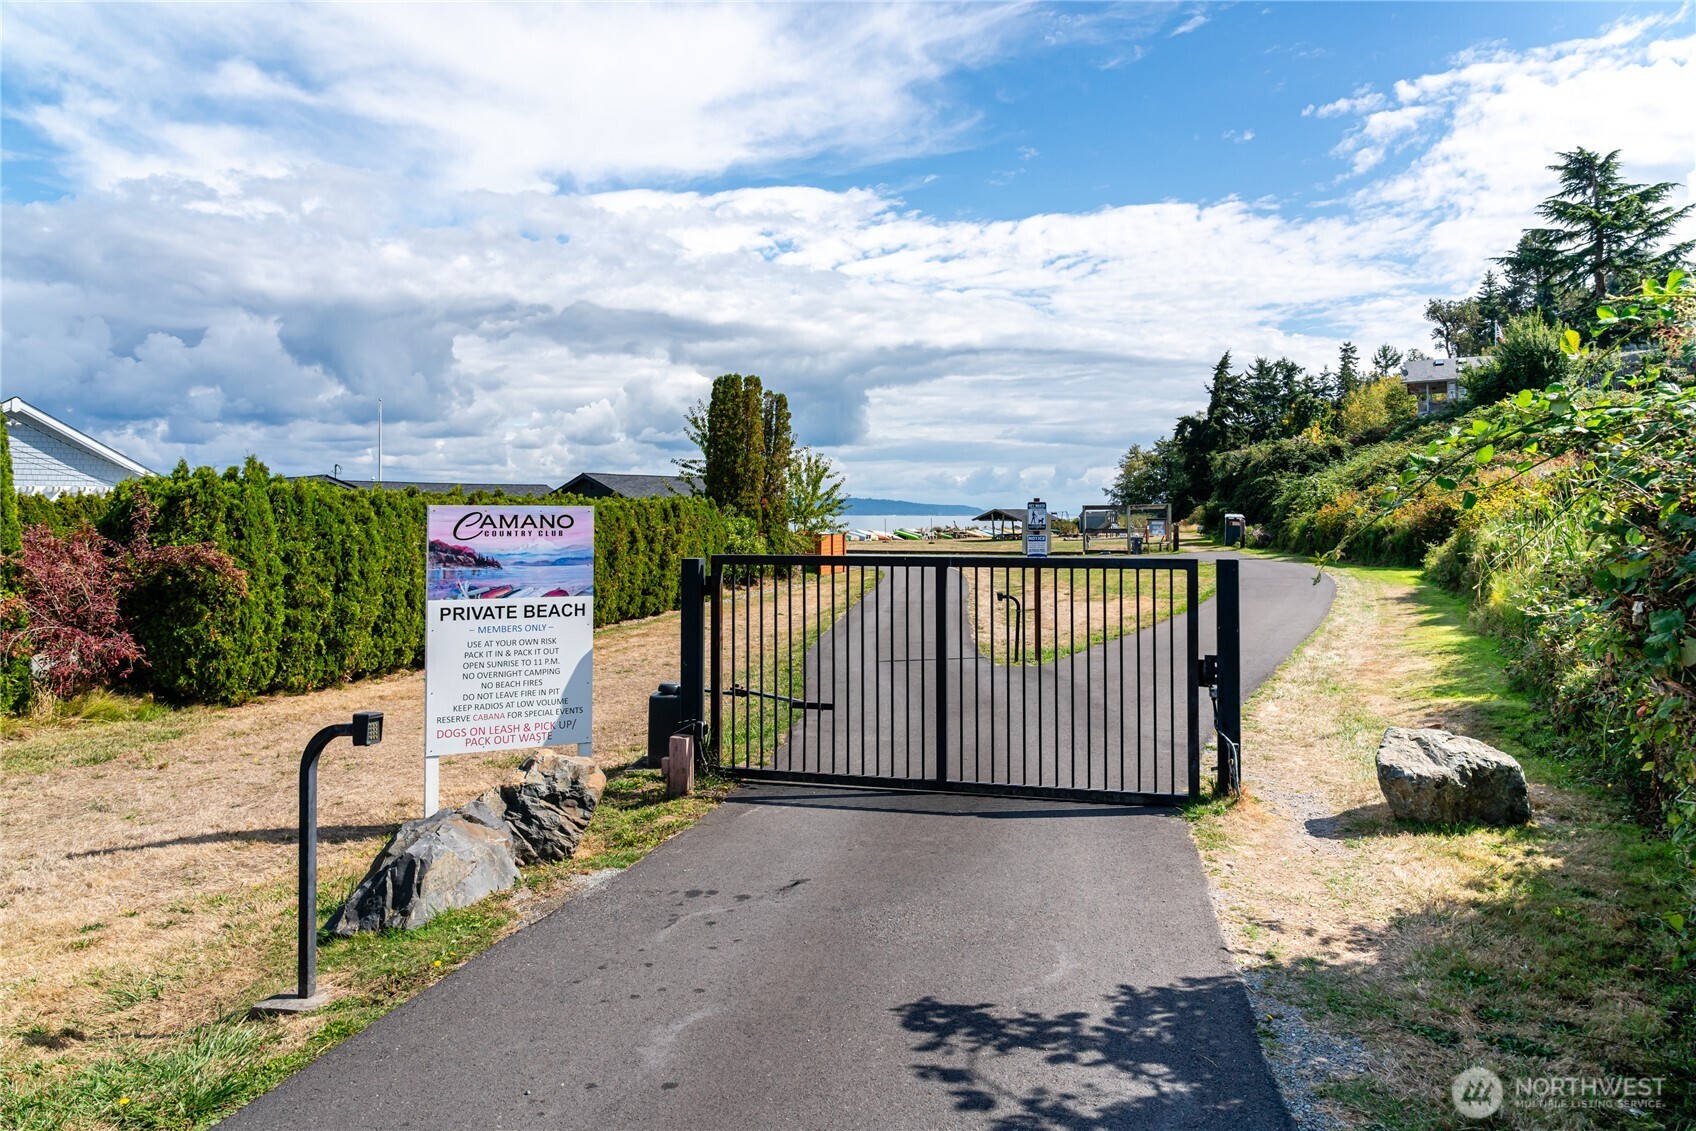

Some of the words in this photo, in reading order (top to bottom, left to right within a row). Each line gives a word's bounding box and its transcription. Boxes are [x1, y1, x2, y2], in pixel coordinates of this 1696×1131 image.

[453, 512, 574, 540] CAMANO
[440, 606, 517, 621] PRIVATE
[524, 603, 585, 618] BEACH
[478, 625, 522, 633] MEMBERS
[487, 660, 519, 668] SUNRISE
[477, 670, 522, 679] OVERNIGHT
[536, 698, 568, 706] VOLUME
[437, 715, 470, 723] RESERVE
[473, 713, 505, 721] CABANA
[525, 709, 553, 717] SPECIAL
[556, 707, 583, 715] EVENTS
[437, 728, 466, 739] DOGS
[470, 727, 485, 736] ON
[489, 724, 520, 734] LEASH
[524, 723, 530, 732] &
[535, 722, 555, 731] PICK
[558, 719, 576, 730] UP/
[466, 736, 490, 747] PACK
[494, 734, 515, 745] OUT
[519, 732, 552, 742] WASTE
